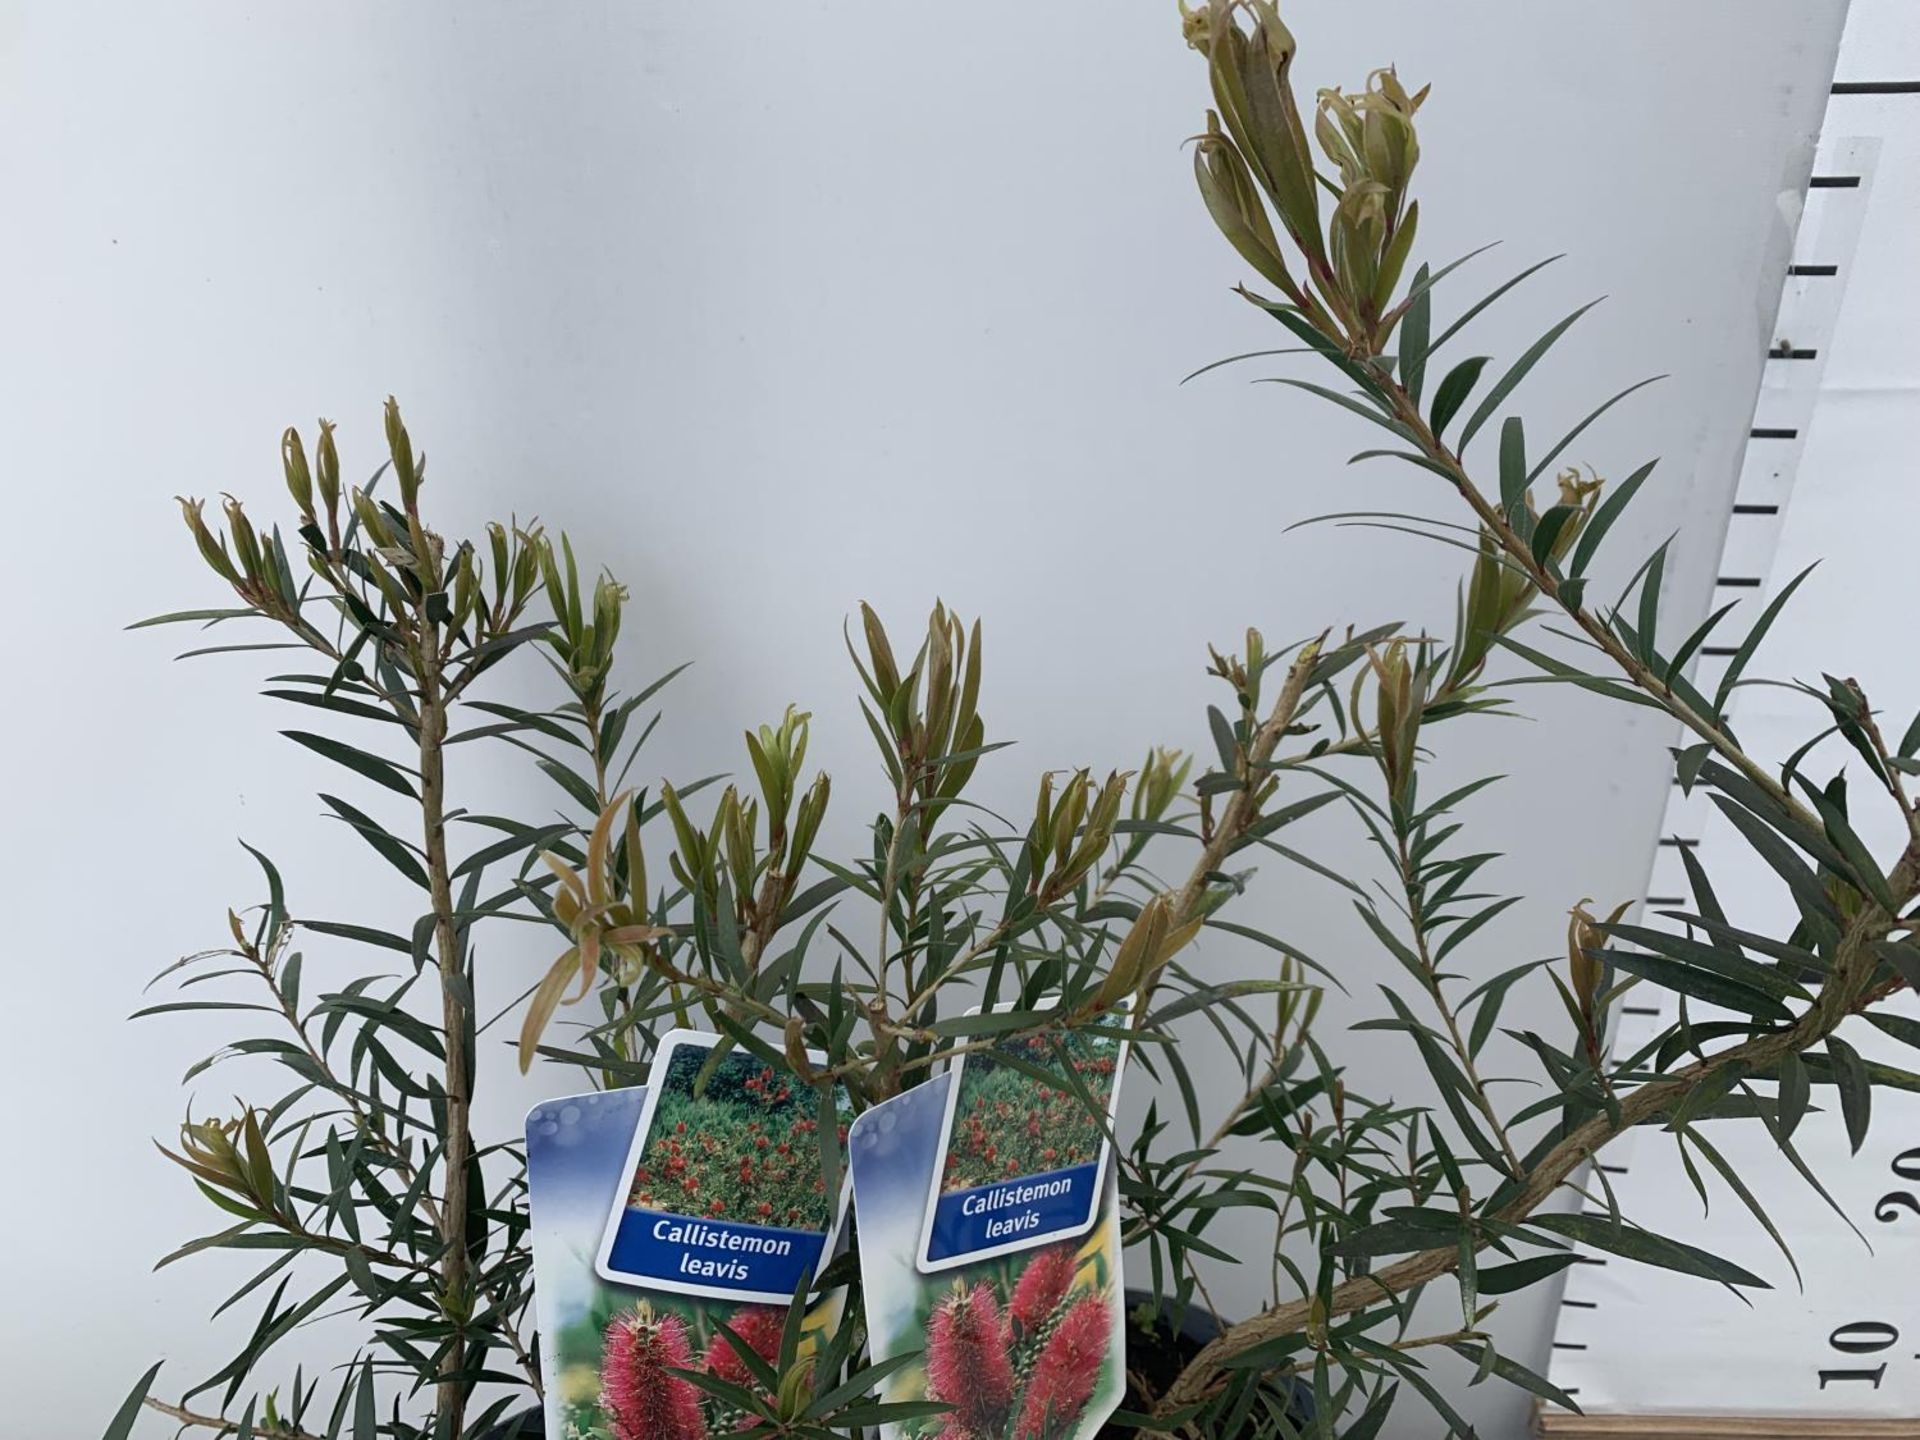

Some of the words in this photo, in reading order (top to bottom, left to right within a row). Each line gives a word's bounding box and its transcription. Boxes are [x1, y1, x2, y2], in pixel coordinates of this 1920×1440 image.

[962, 1177, 1072, 1216] Callistemon
[653, 1220, 791, 1256] Callistemon
[985, 1209, 1040, 1239] leavis
[680, 1253, 749, 1280] leavis
[1818, 1321, 1899, 1389] 10
